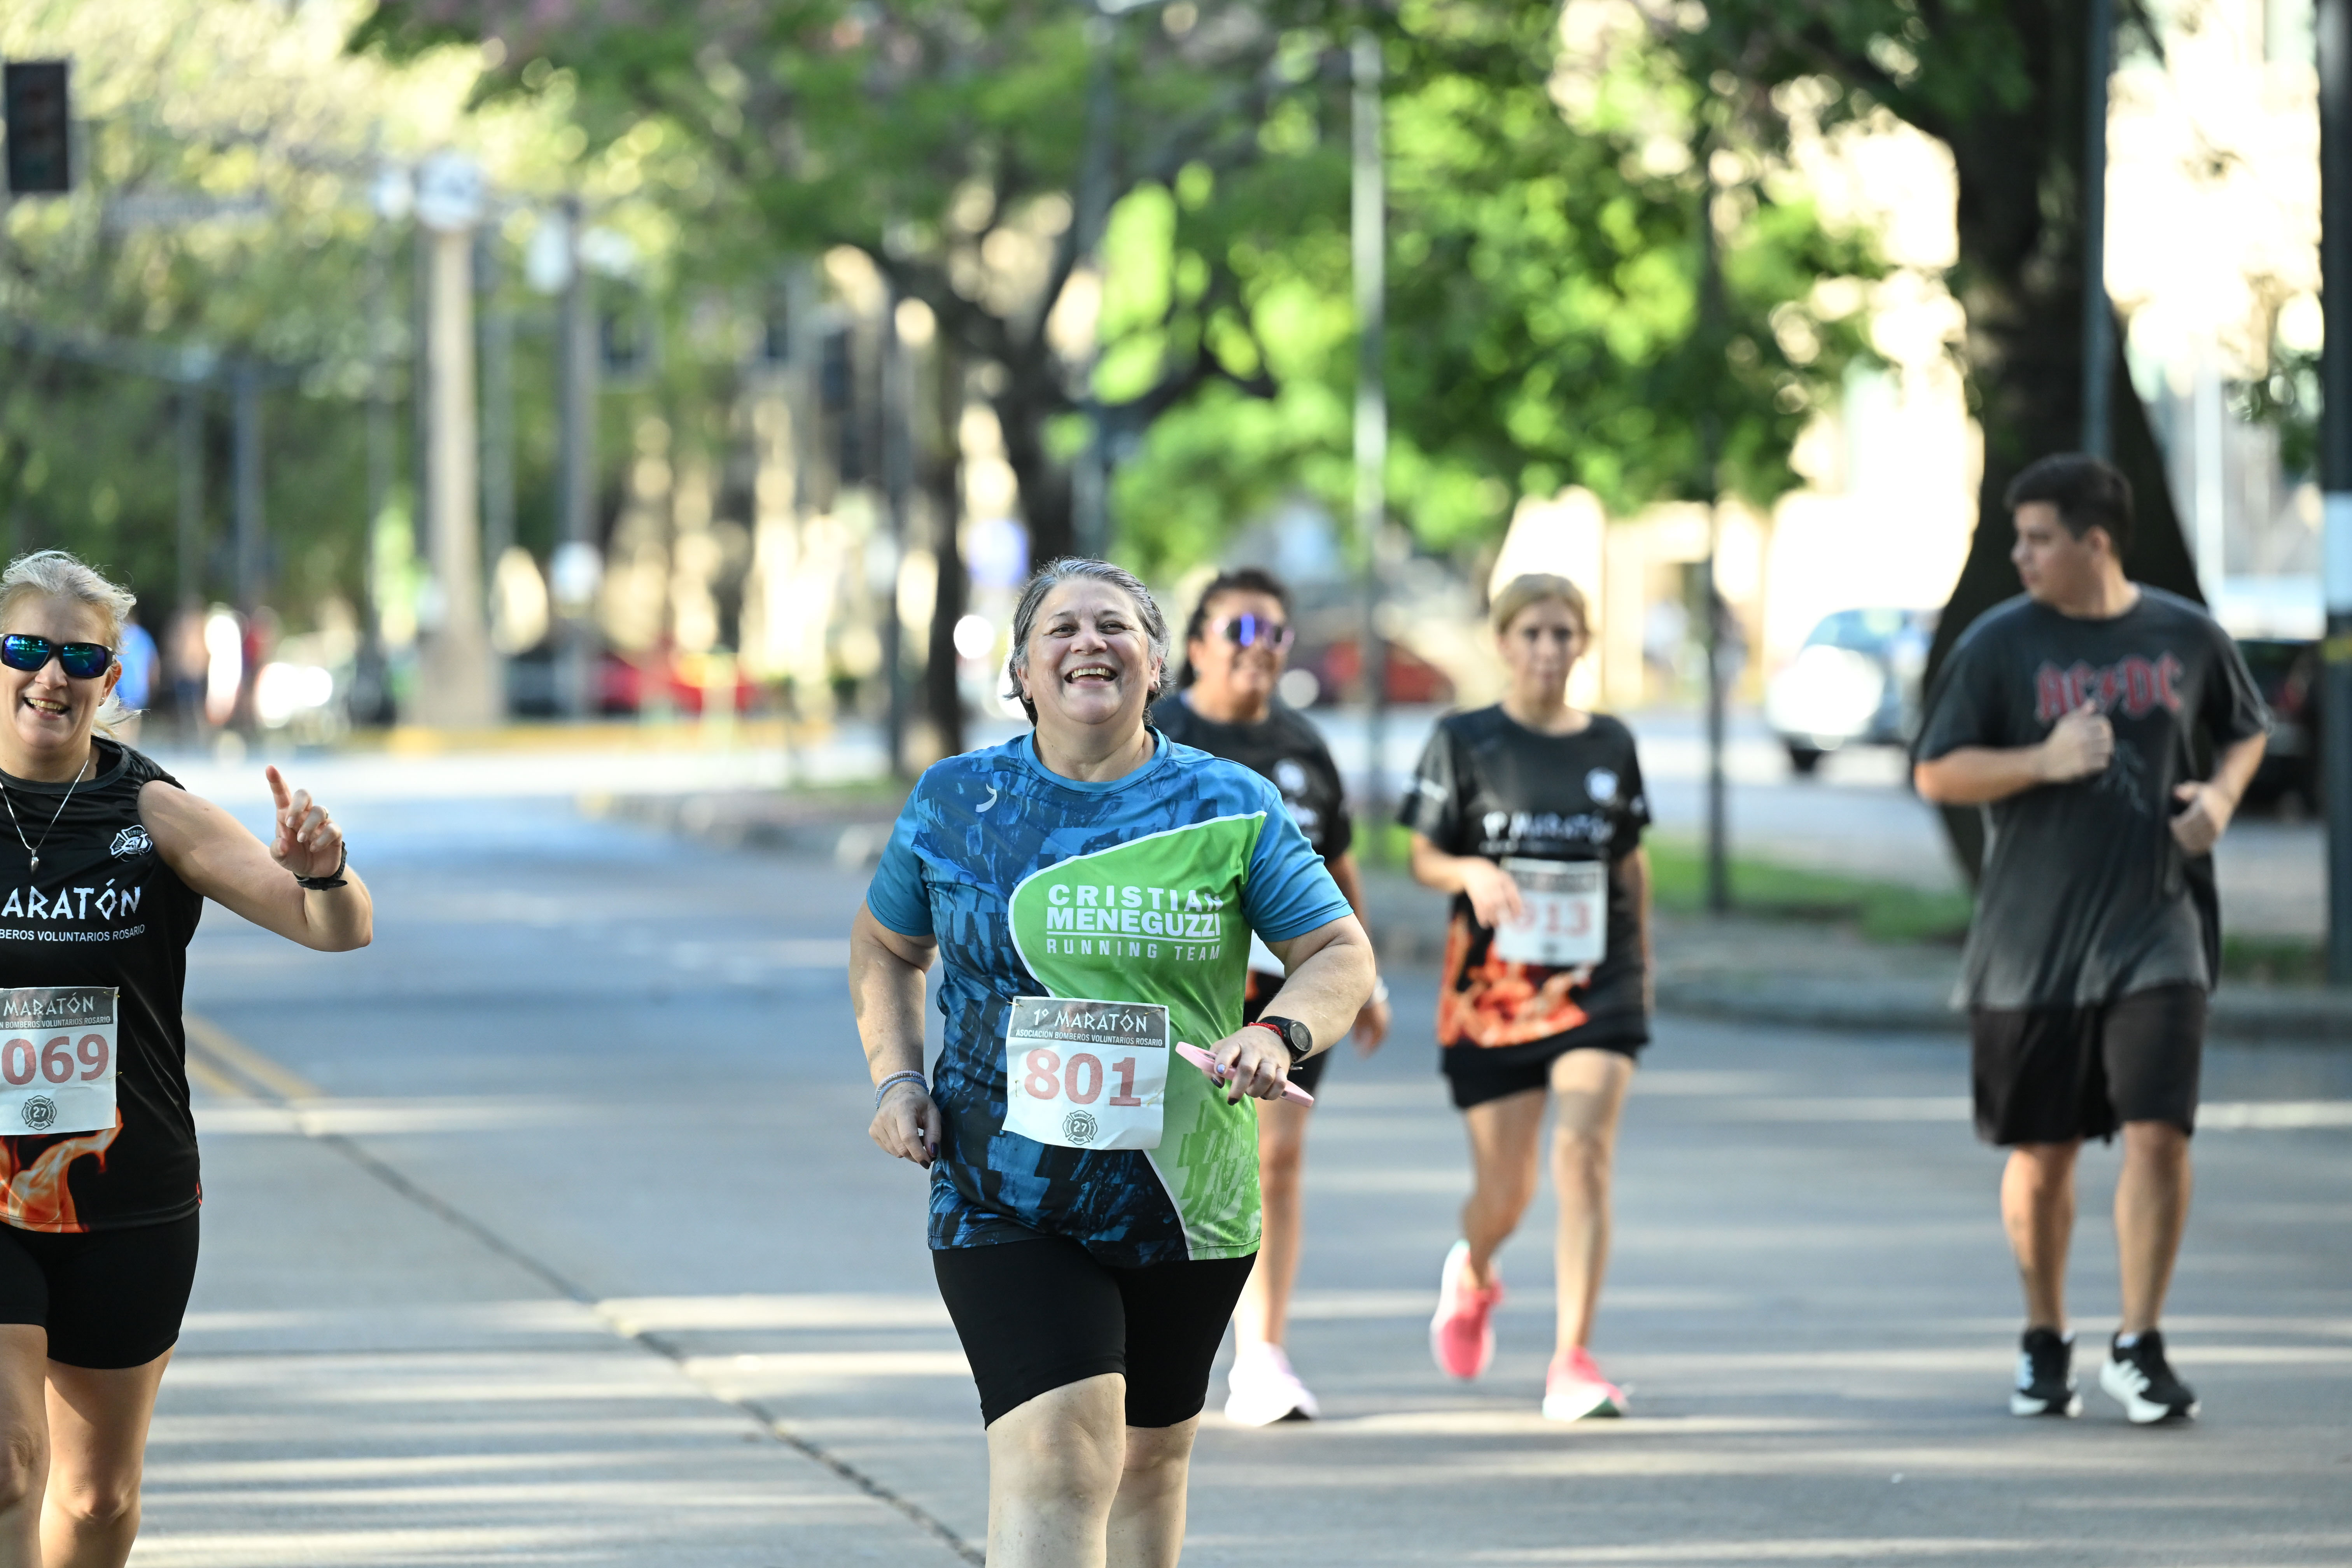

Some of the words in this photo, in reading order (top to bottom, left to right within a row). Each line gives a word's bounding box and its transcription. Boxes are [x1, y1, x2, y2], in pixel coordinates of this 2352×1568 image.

[1048, 884, 1223, 912] CRISTIAN
[37, 931, 110, 942] VOLUNTARIOS
[112, 924, 145, 940] ROSARIO
[1046, 906, 1221, 937] MENEGUZZI
[1046, 938, 1157, 959] RUNNING
[1174, 945, 1220, 961] TEAM
[3, 992, 94, 1017] MARATÓN
[42, 1018, 83, 1027] VOLUNTARIOS
[84, 1016, 111, 1024] ROSARIO
[1054, 1009, 1147, 1033] MARATÓN
[1015, 1029, 1053, 1038] ASOCIACIÓN
[1055, 1031, 1090, 1041] BOMBEROS
[1091, 1034, 1134, 1045] VOLUNTARIOS
[1136, 1038, 1163, 1046] ROSARIO
[1, 1034, 109, 1085] 069
[1024, 1049, 1141, 1106] 801
[33, 1106, 46, 1118] 27
[1073, 1120, 1087, 1132] 27
